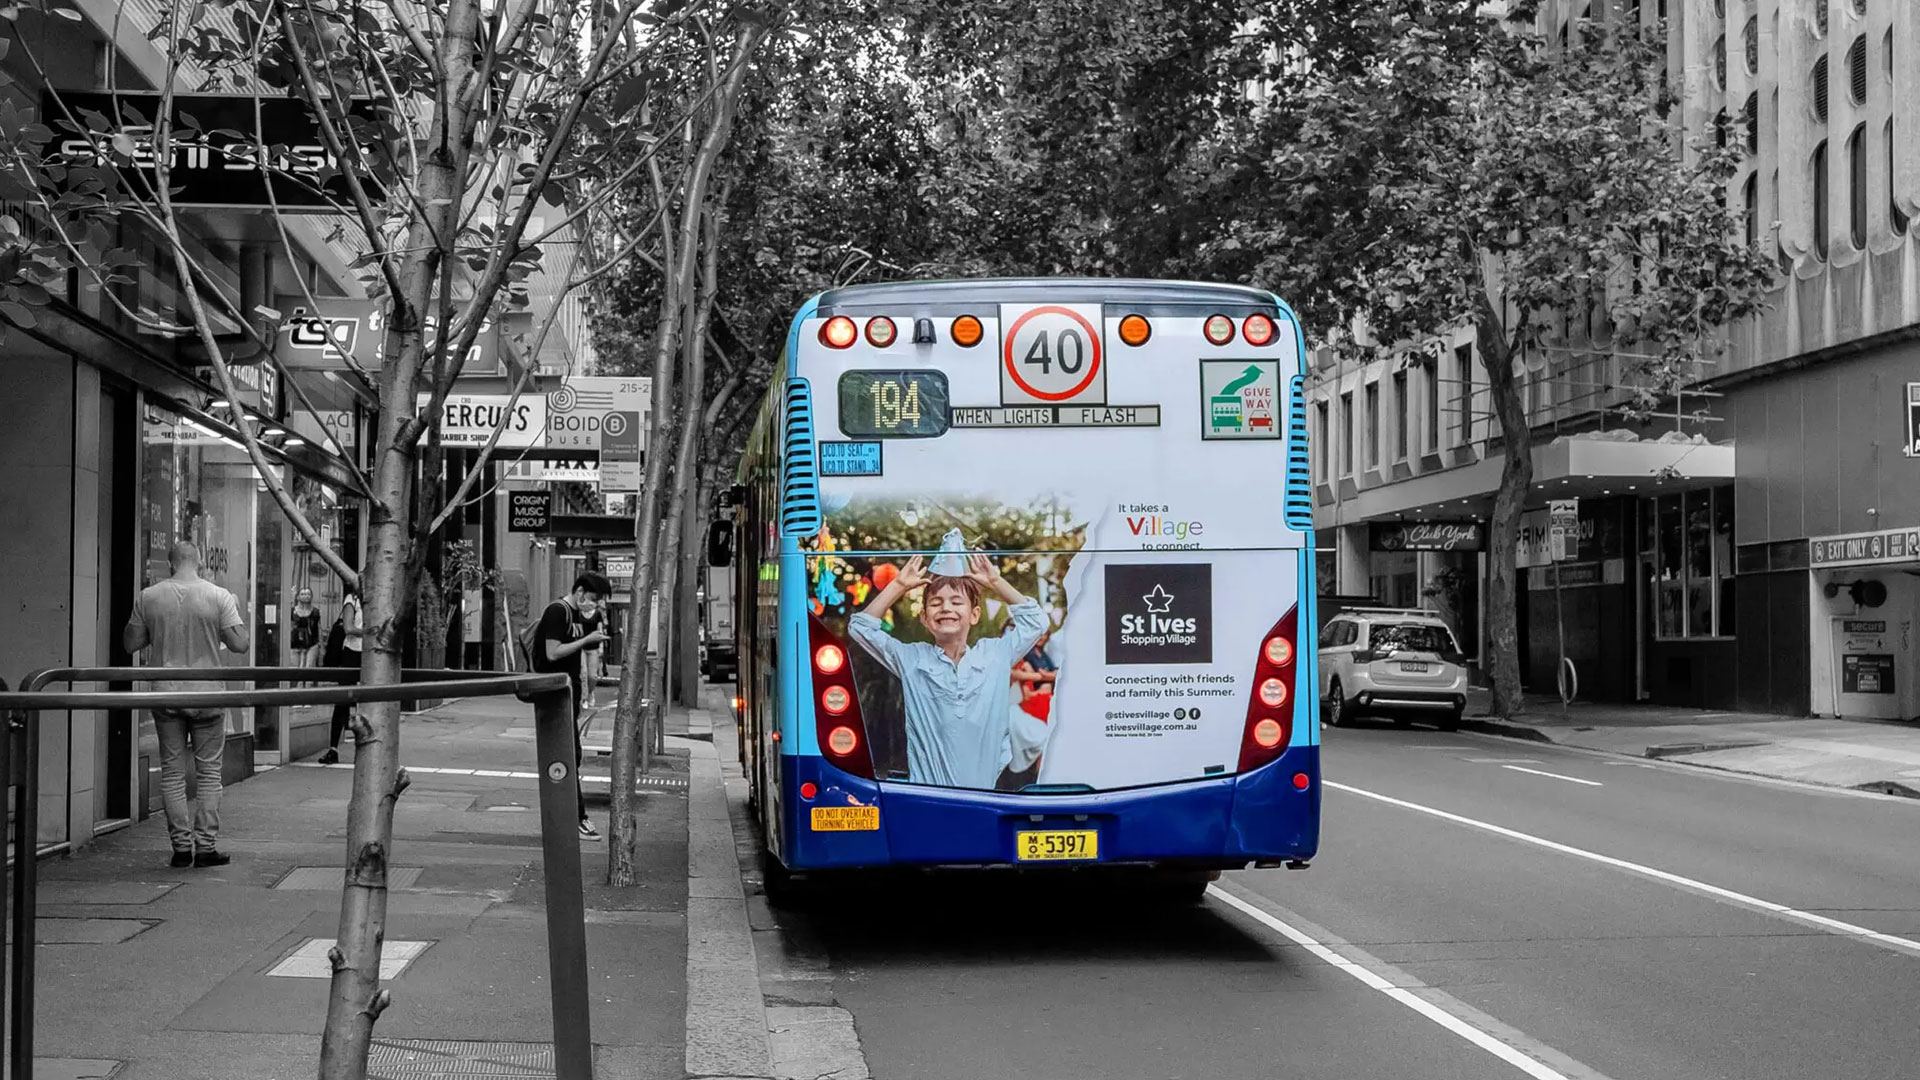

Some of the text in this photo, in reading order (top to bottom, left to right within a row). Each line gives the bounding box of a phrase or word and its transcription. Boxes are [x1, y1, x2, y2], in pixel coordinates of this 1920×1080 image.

[1024, 329, 1083, 374] 40
[1244, 388, 1271, 397] GIVE
[870, 380, 920, 428] 194
[1246, 400, 1271, 408] WAY
[956, 409, 1136, 424] WHEN LIGHTS FLASH
[549, 416, 600, 431] BOID
[610, 418, 620, 432] B
[1118, 504, 1126, 513] It
[1130, 504, 1159, 513] takes
[513, 518, 546, 527] GROUP
[1126, 515, 1203, 540] Village
[1410, 524, 1475, 551] Club York
[1517, 521, 1550, 548] PRIM
[1828, 539, 1867, 559] EXIT ONLY
[1121, 613, 1197, 634] St Ives
[1121, 634, 1196, 646] Shopping Village
[1105, 674, 1235, 685] Connecting with friends
[1105, 688, 1235, 699] and family this Summer.
[1105, 711, 1170, 720] @stivesvillage
[1105, 723, 1197, 732] stivesvillage.com.au
[815, 809, 874, 819] DO NOT OVERTAKE
[816, 819, 874, 829] TURNING VEHICLE
[1045, 834, 1086, 853] 5397
